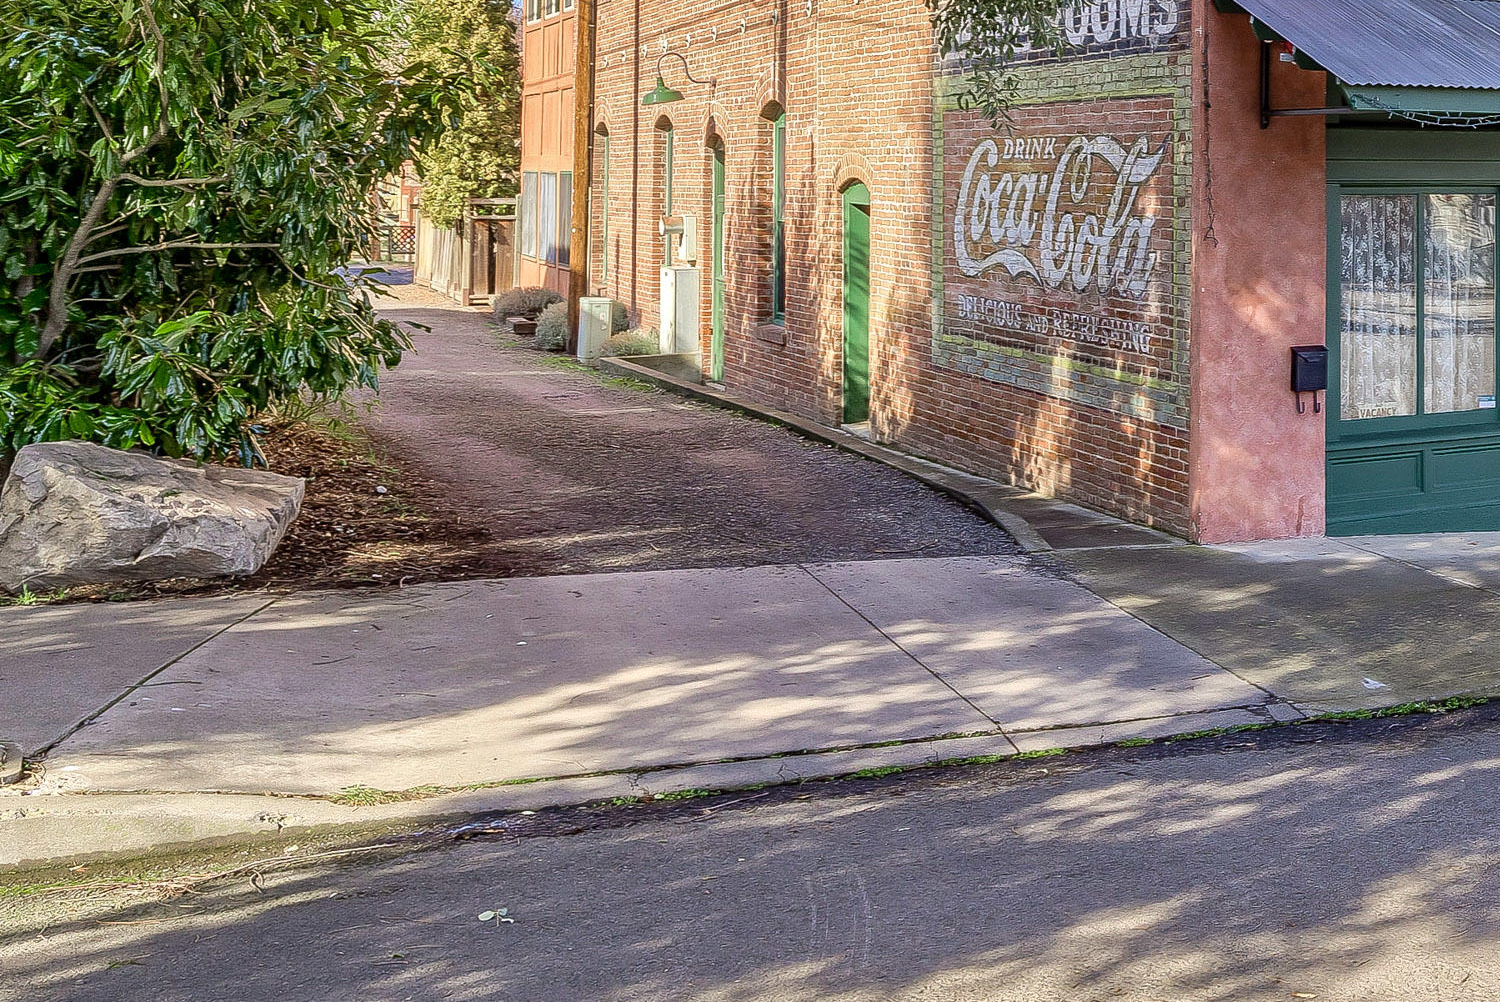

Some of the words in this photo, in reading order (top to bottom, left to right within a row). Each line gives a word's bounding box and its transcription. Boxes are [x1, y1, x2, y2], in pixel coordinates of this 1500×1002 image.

[1002, 137, 1057, 160] DRINK
[1026, 314, 1049, 334] AND
[1360, 407, 1397, 418] VACANCY
